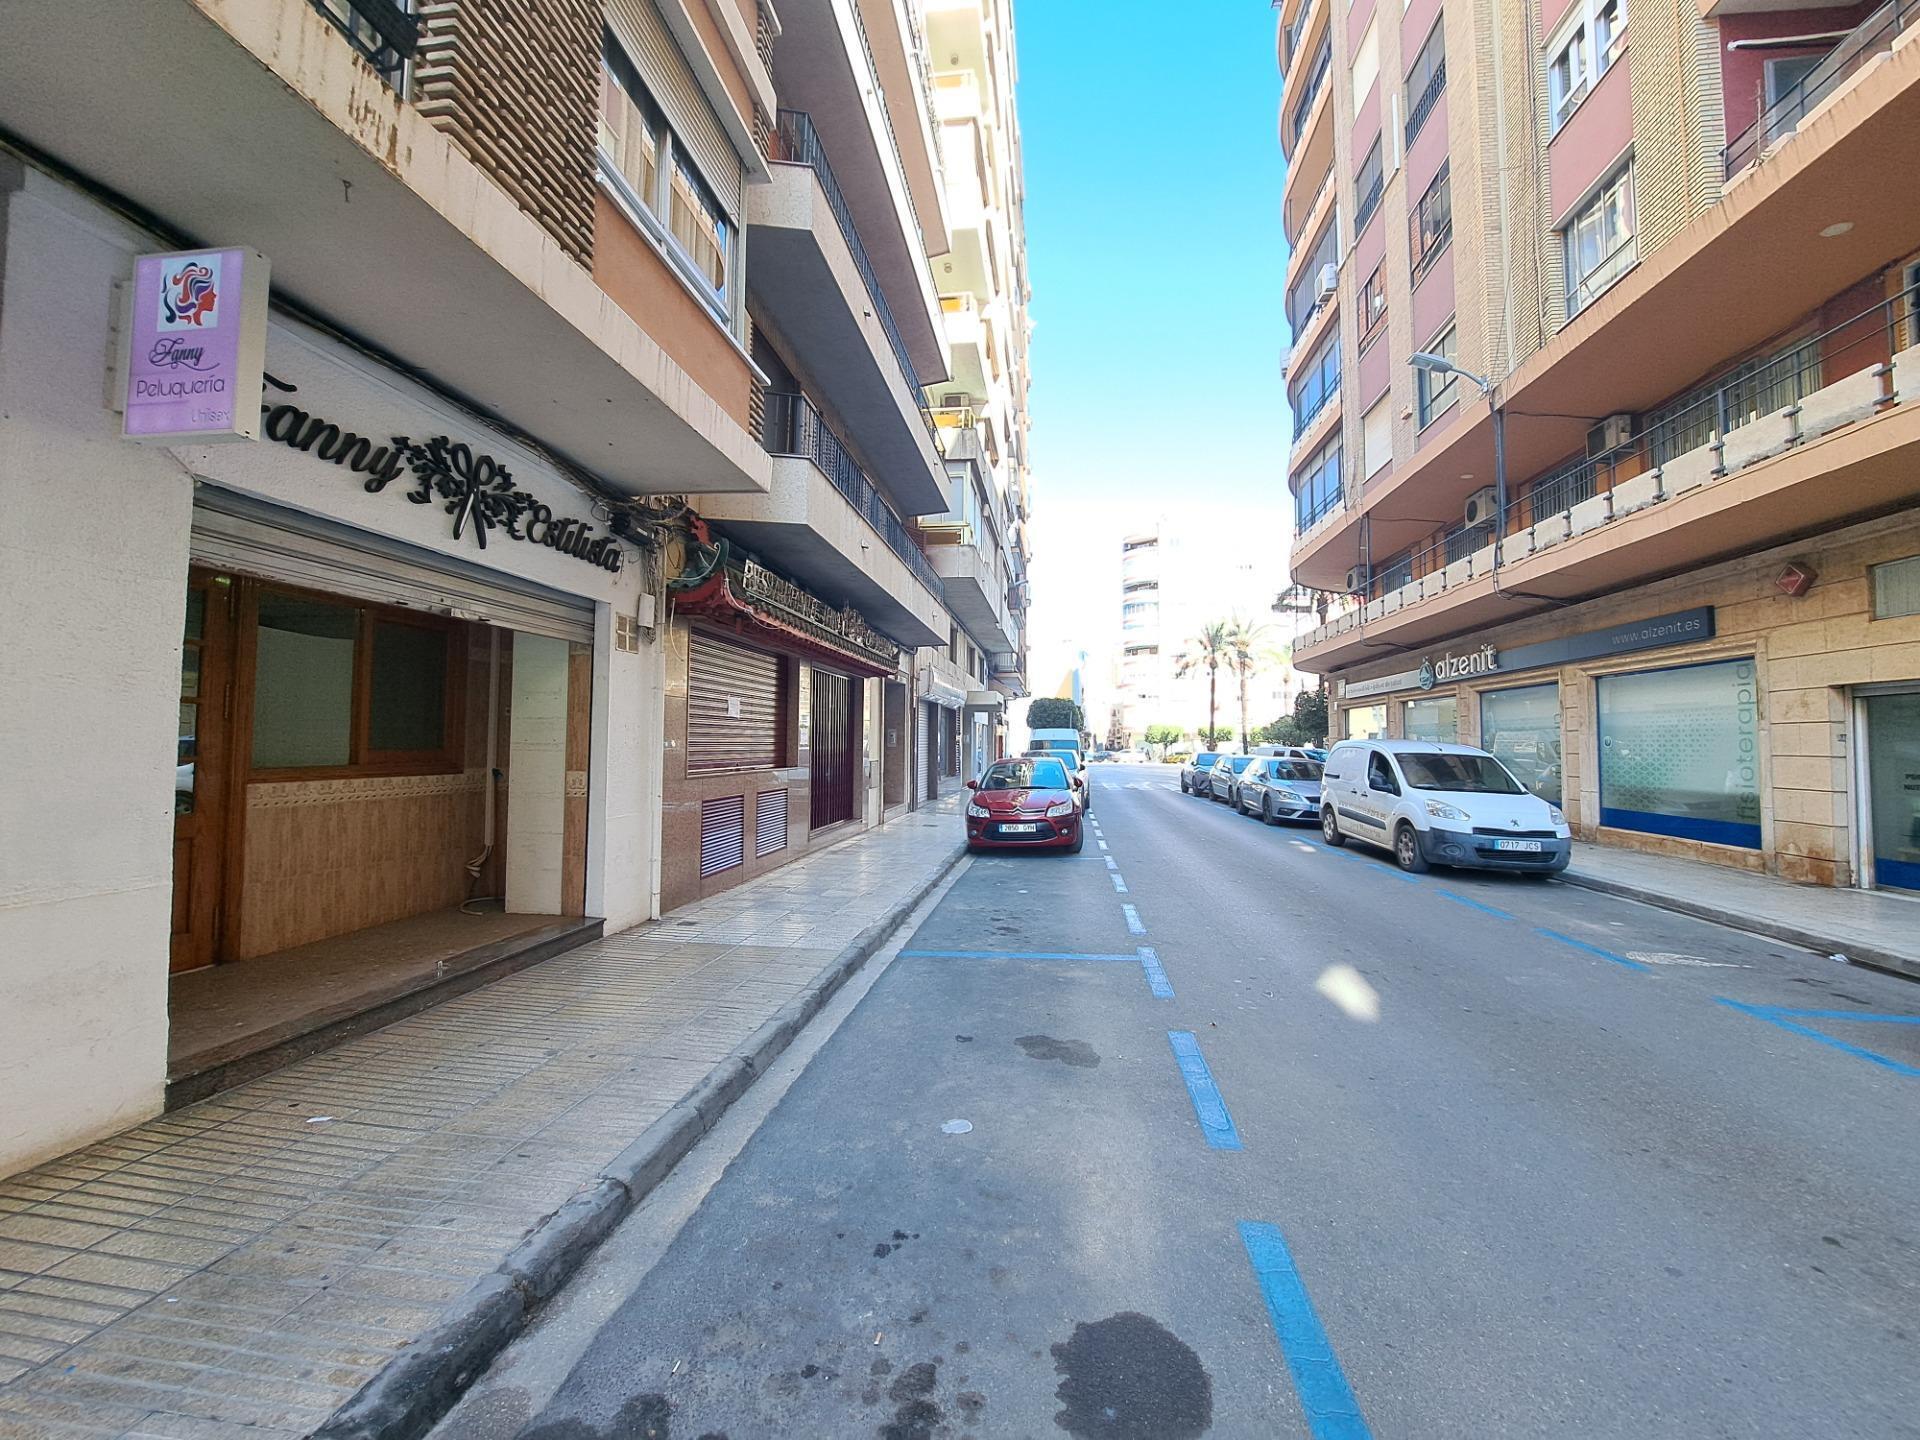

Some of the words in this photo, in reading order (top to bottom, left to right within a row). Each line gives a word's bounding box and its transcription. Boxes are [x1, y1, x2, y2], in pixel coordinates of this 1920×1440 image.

[148, 338, 220, 371] Fanny
[137, 375, 225, 398] Peluquería
[262, 372, 404, 493] anny
[526, 504, 624, 573] Estilista
[1611, 616, 1701, 646] www.alzenit.es
[1435, 644, 1497, 679] alzenit
[1500, 841, 1519, 849] 0717
